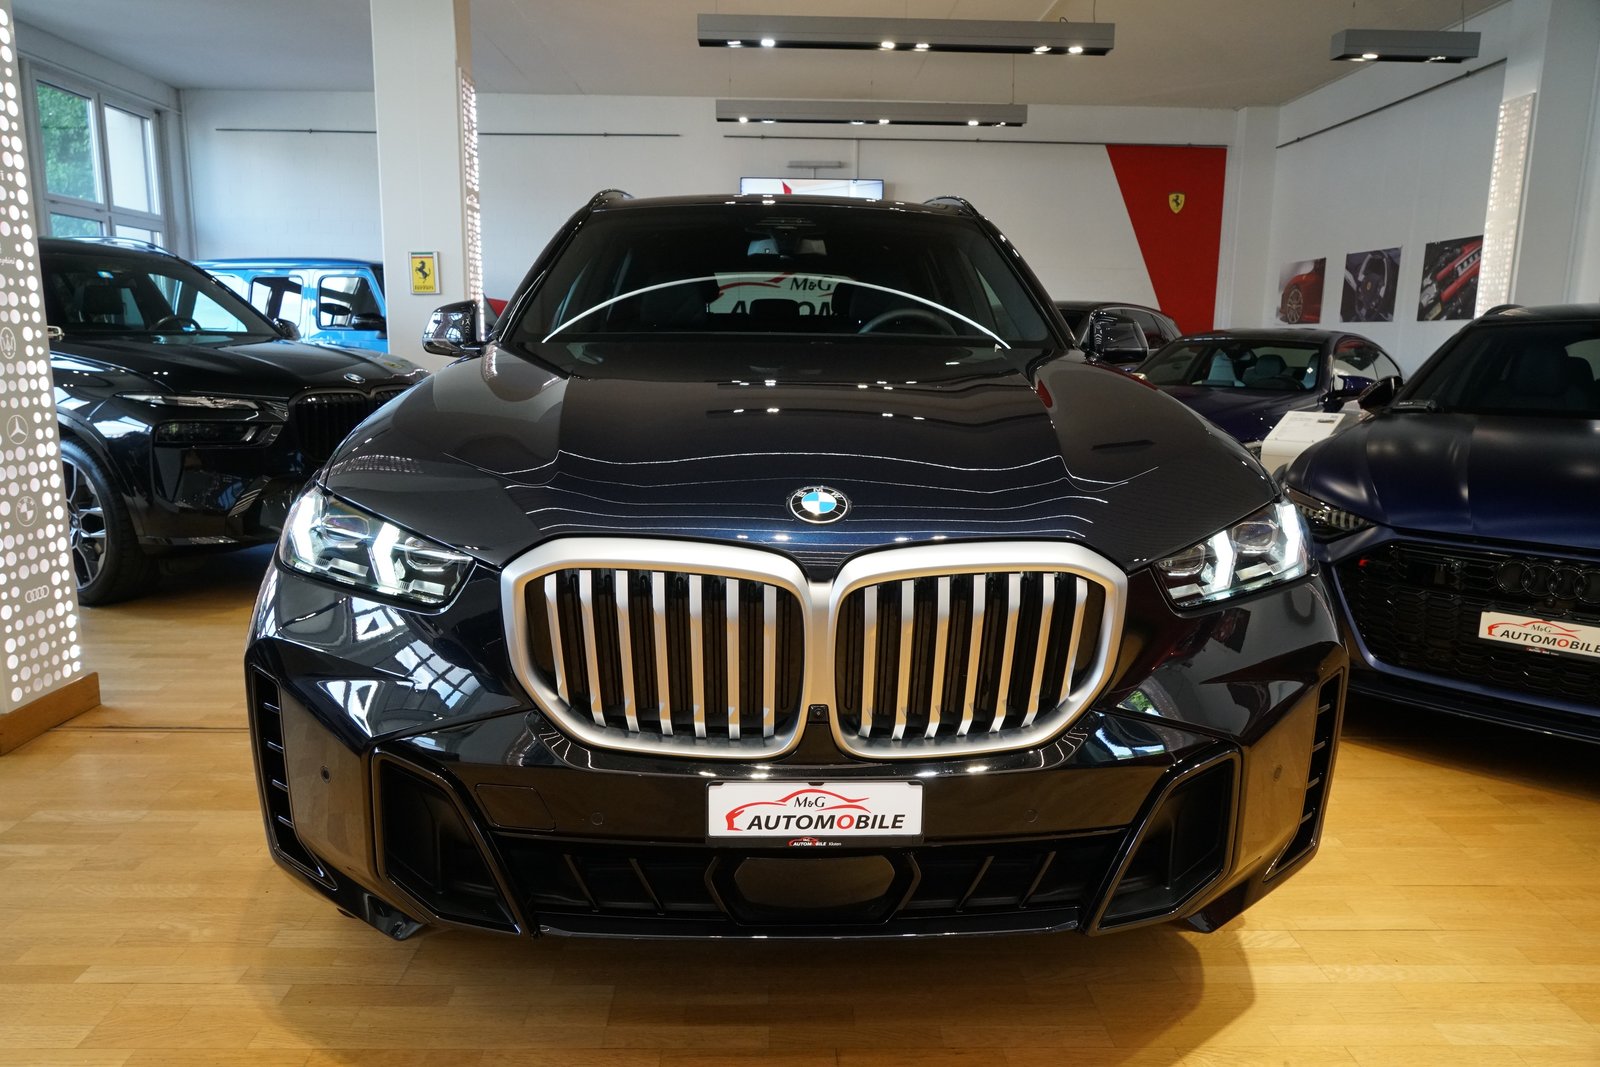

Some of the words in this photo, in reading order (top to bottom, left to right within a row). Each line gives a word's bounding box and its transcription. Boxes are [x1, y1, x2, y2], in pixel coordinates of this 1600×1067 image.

[790, 277, 832, 290] M&G
[1531, 624, 1552, 633] M&G
[1500, 629, 1600, 654] AUTOMOBILE
[793, 796, 826, 808] M&G
[746, 814, 906, 831] AUTOMOBILE
